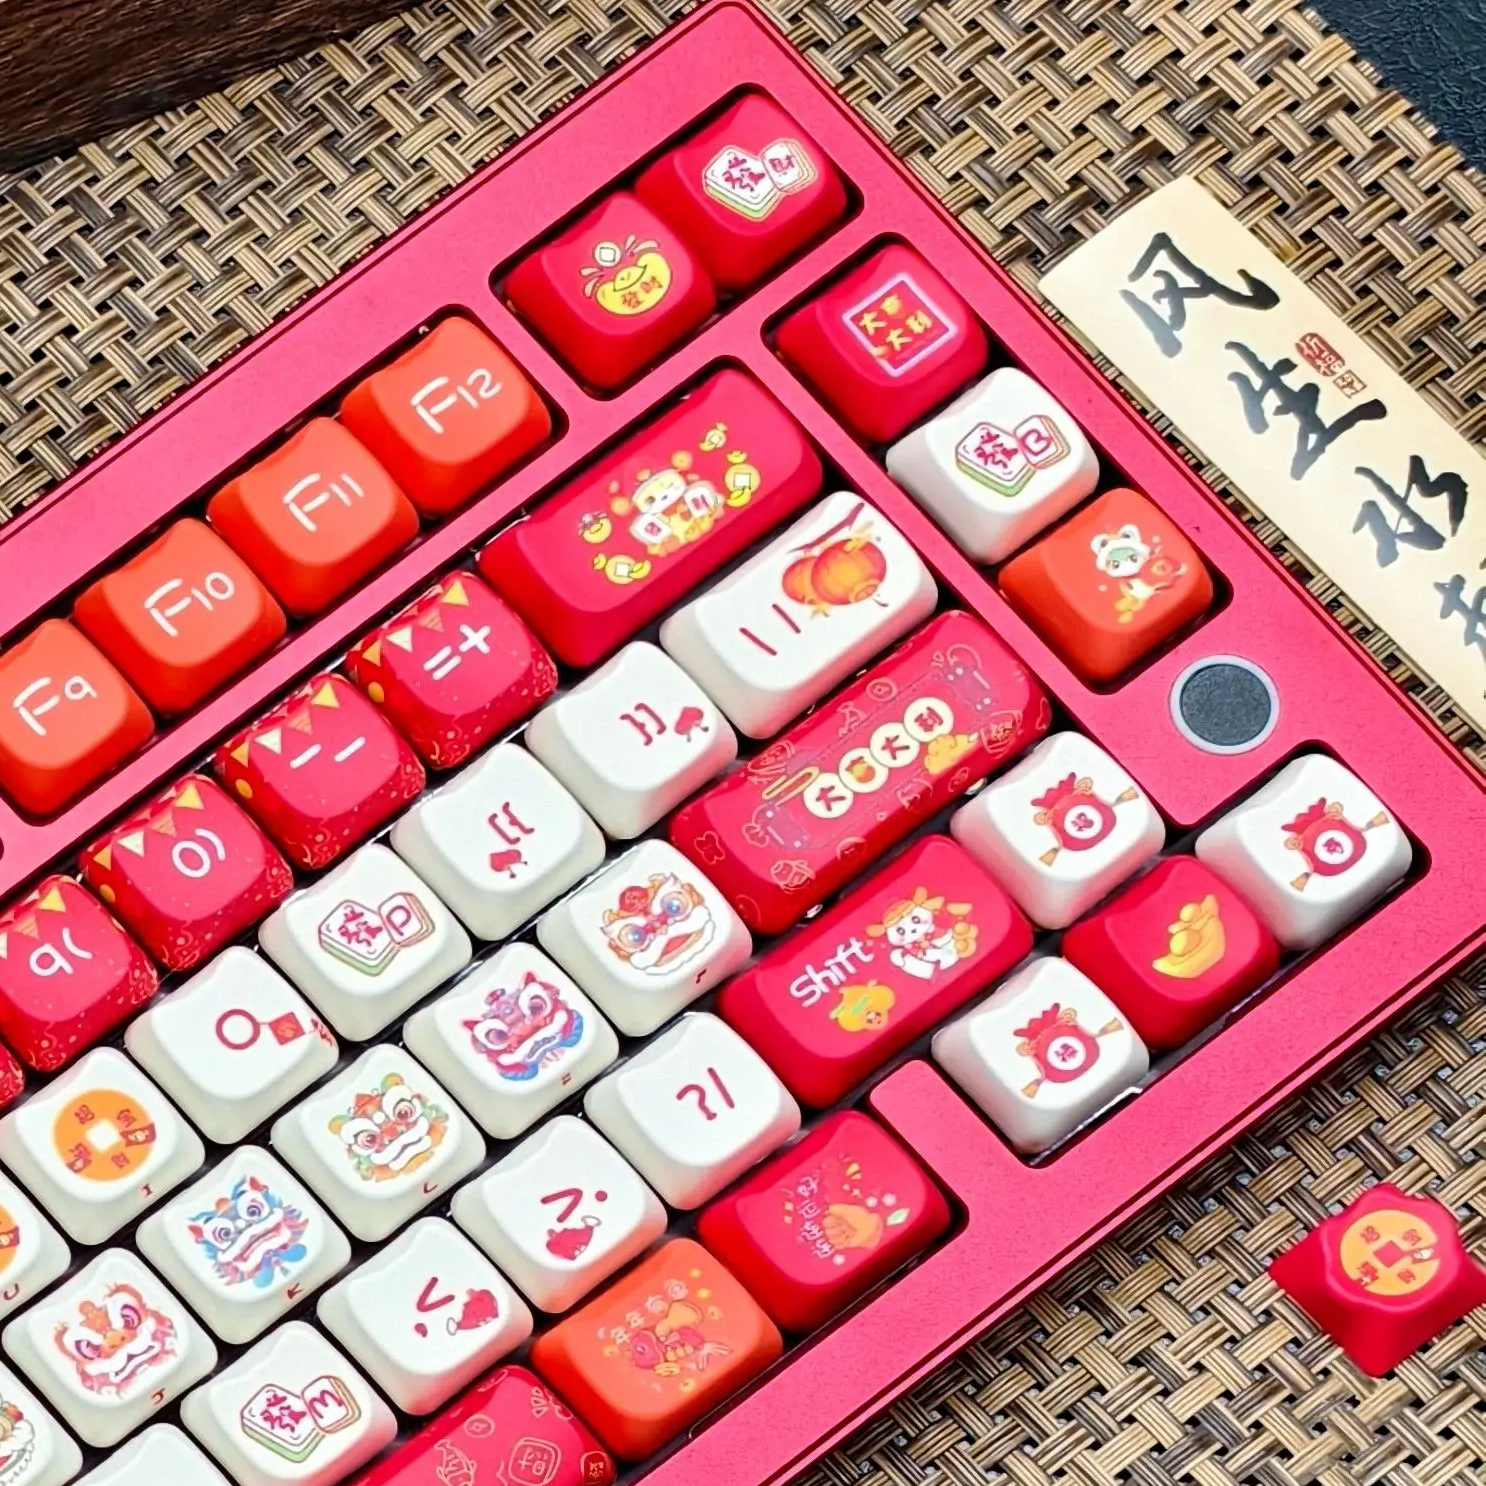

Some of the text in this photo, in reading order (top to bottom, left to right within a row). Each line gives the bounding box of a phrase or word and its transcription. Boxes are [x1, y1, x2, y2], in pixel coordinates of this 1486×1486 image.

[412, 369, 500, 432] F12
[1022, 430, 1050, 456] B
[284, 474, 362, 530] F11
[145, 573, 233, 635] F10
[425, 626, 489, 679] =+
[14, 676, 95, 735] F9
[173, 829, 225, 877] 0)
[388, 907, 412, 934] P
[30, 930, 91, 975] 9(
[790, 937, 874, 1007] Shift
[311, 1390, 345, 1421] M
